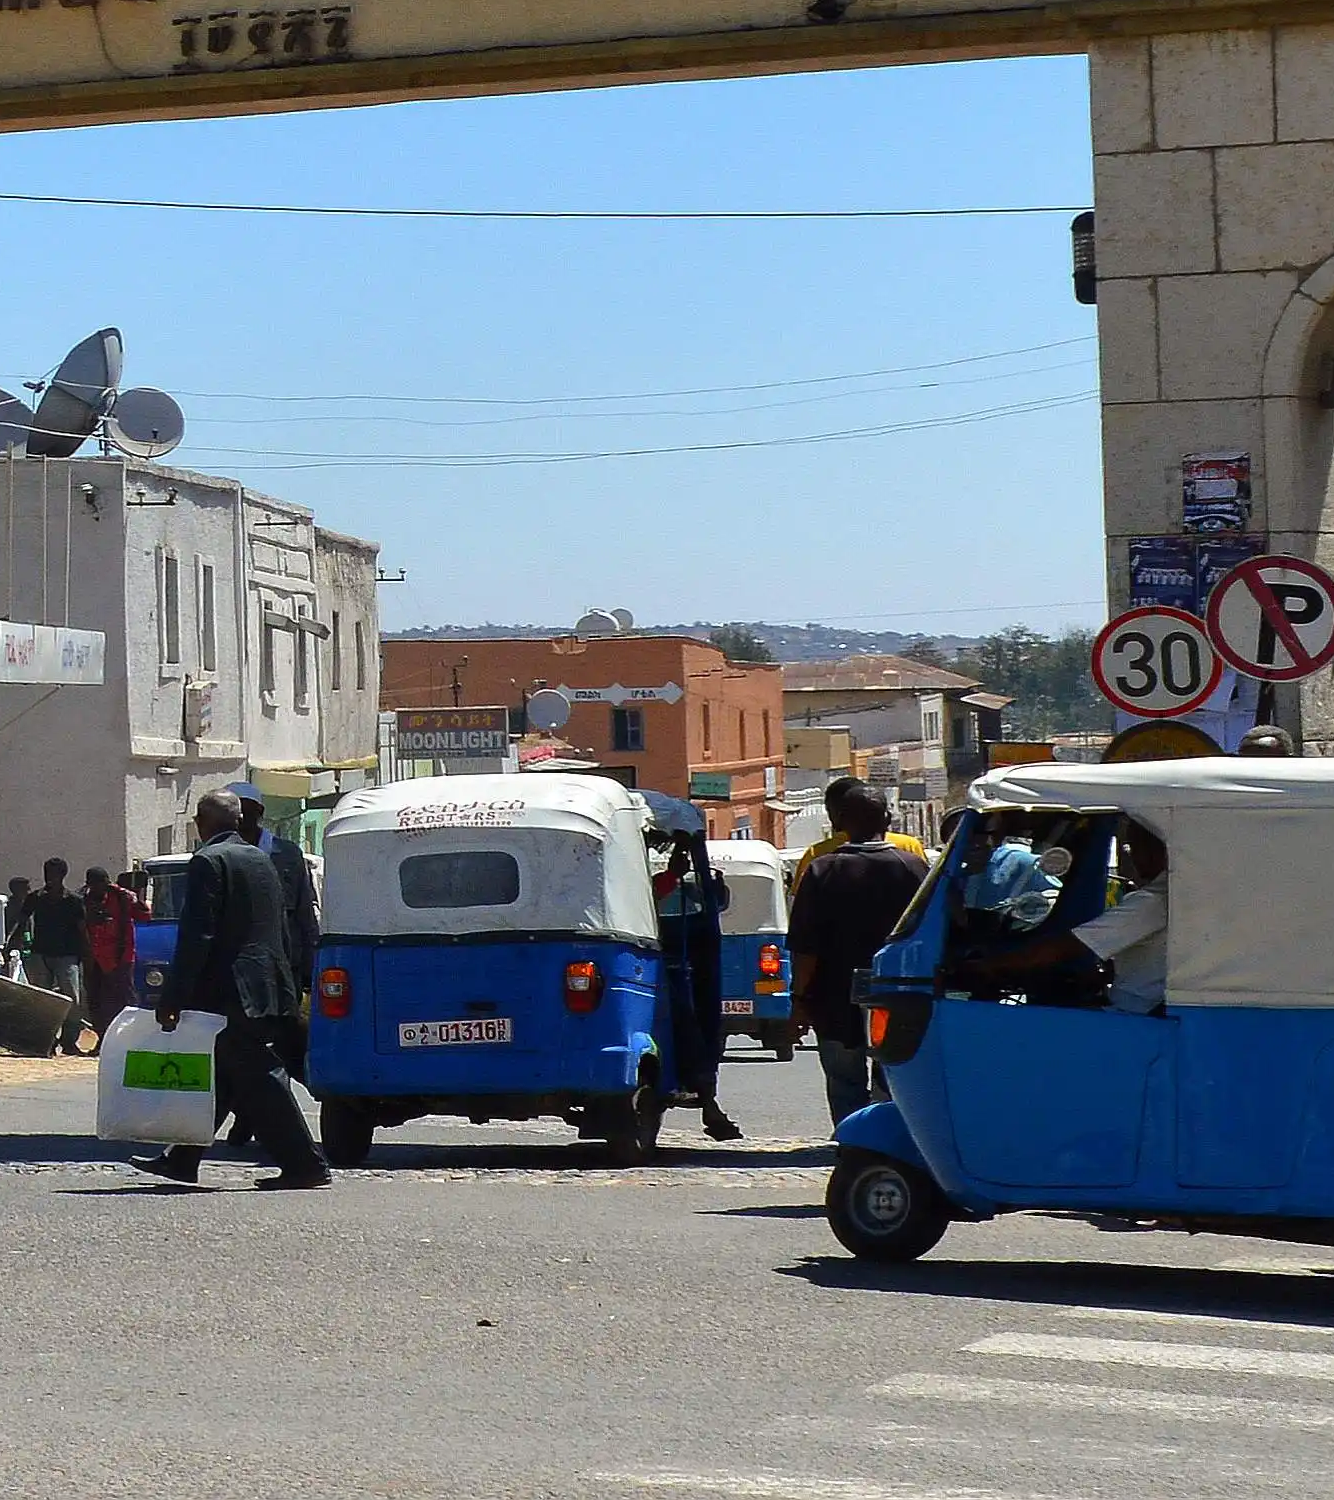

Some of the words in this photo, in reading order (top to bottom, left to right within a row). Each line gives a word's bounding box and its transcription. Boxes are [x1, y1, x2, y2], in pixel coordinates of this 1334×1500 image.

[1112, 631, 1201, 697] 30
[399, 730, 505, 750] MOONLIGHT
[438, 1021, 497, 1043] 01316
